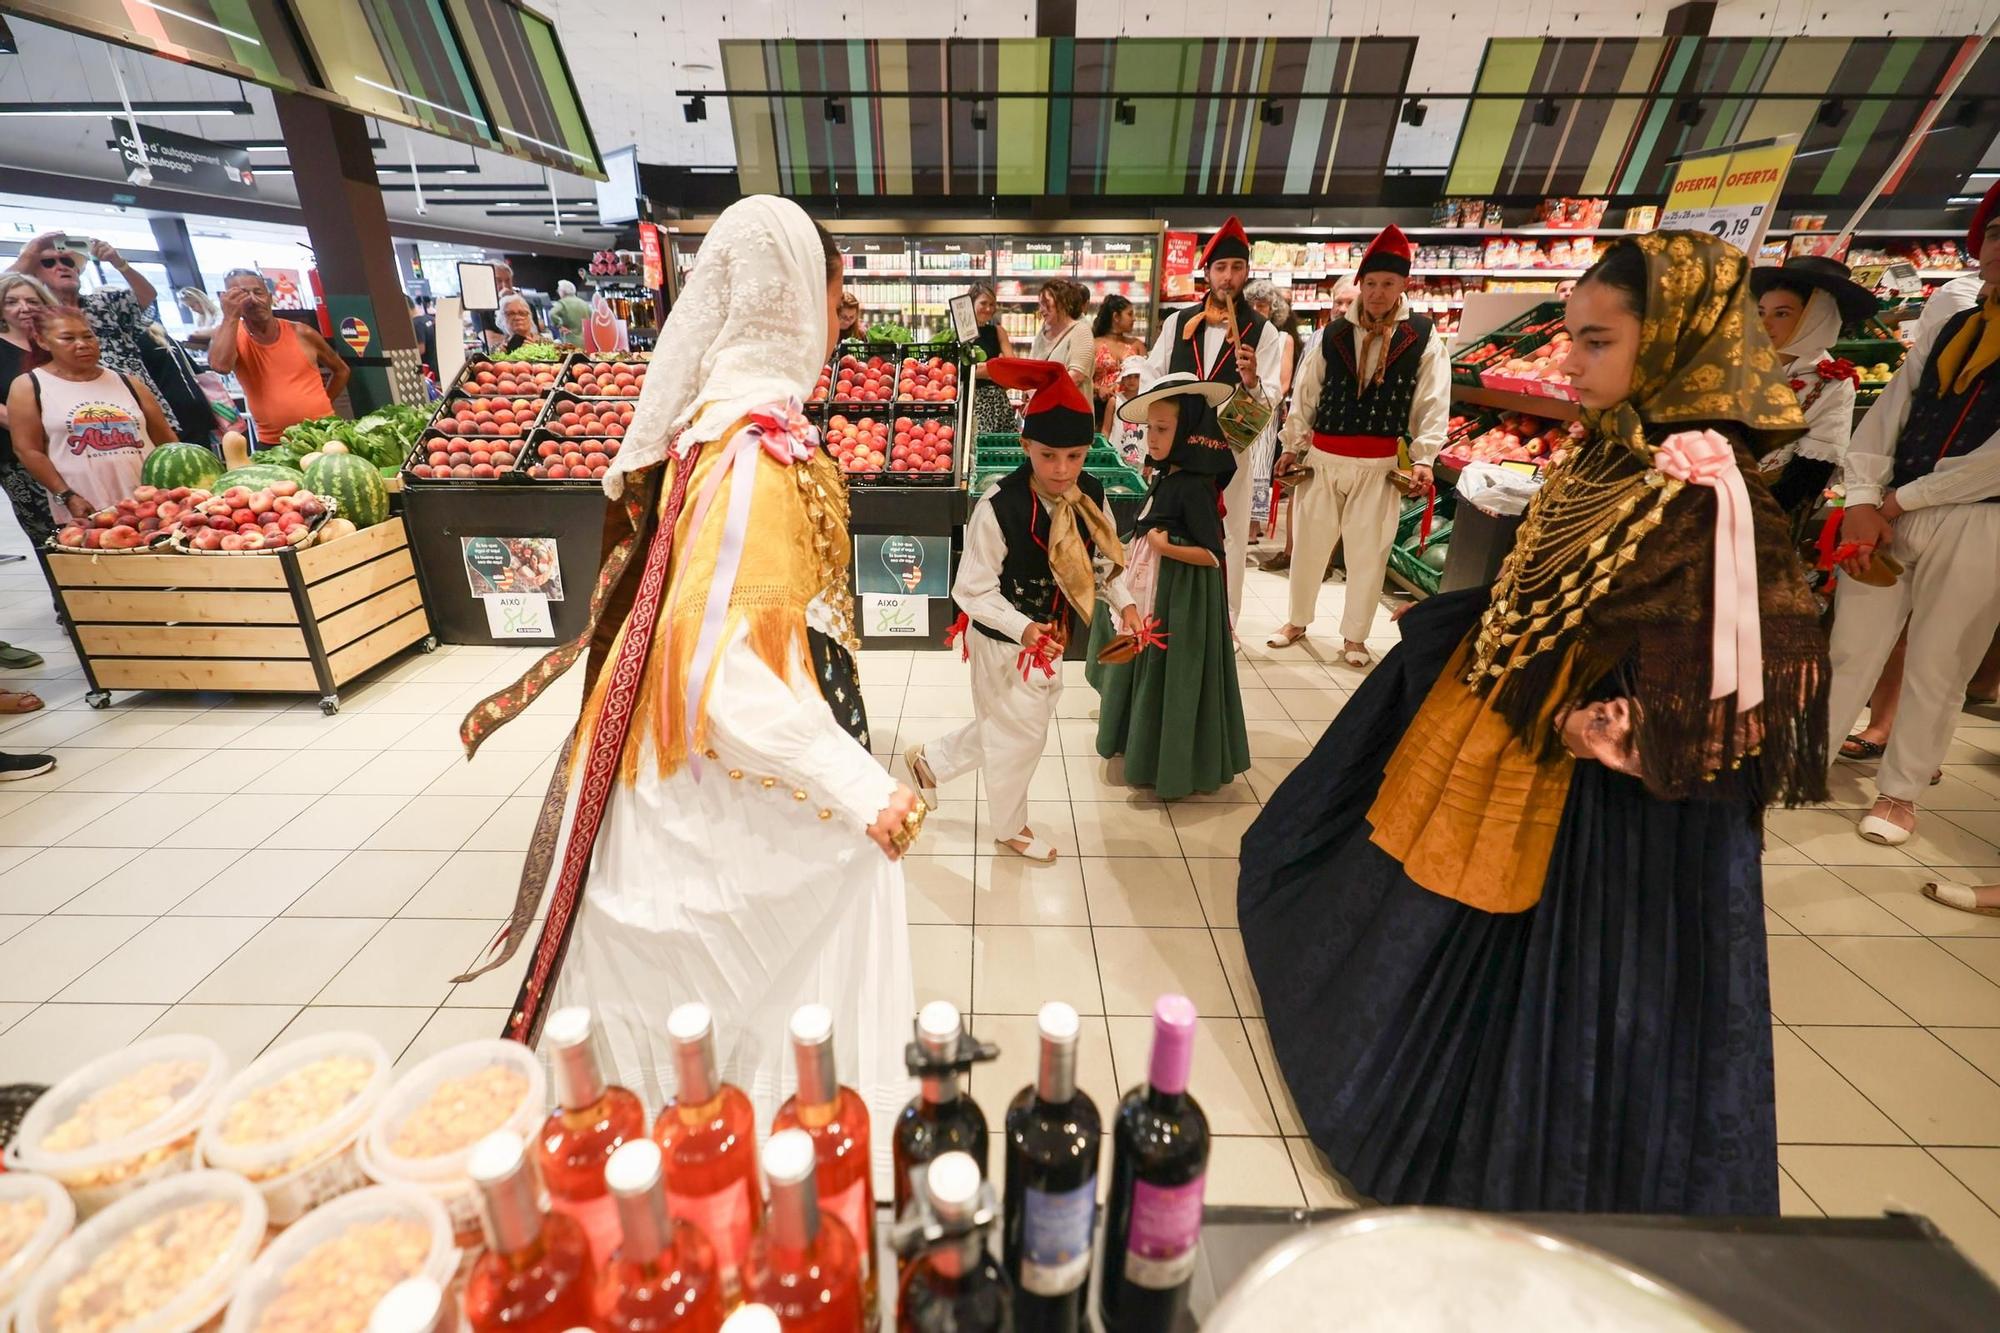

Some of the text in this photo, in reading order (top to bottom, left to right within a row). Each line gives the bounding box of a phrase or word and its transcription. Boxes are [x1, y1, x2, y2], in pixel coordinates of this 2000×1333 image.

[120, 135, 149, 151] Caa
[1675, 176, 1718, 193] OFERTA
[1726, 168, 1779, 187] OFERTA
[67, 427, 145, 455] Aloha
